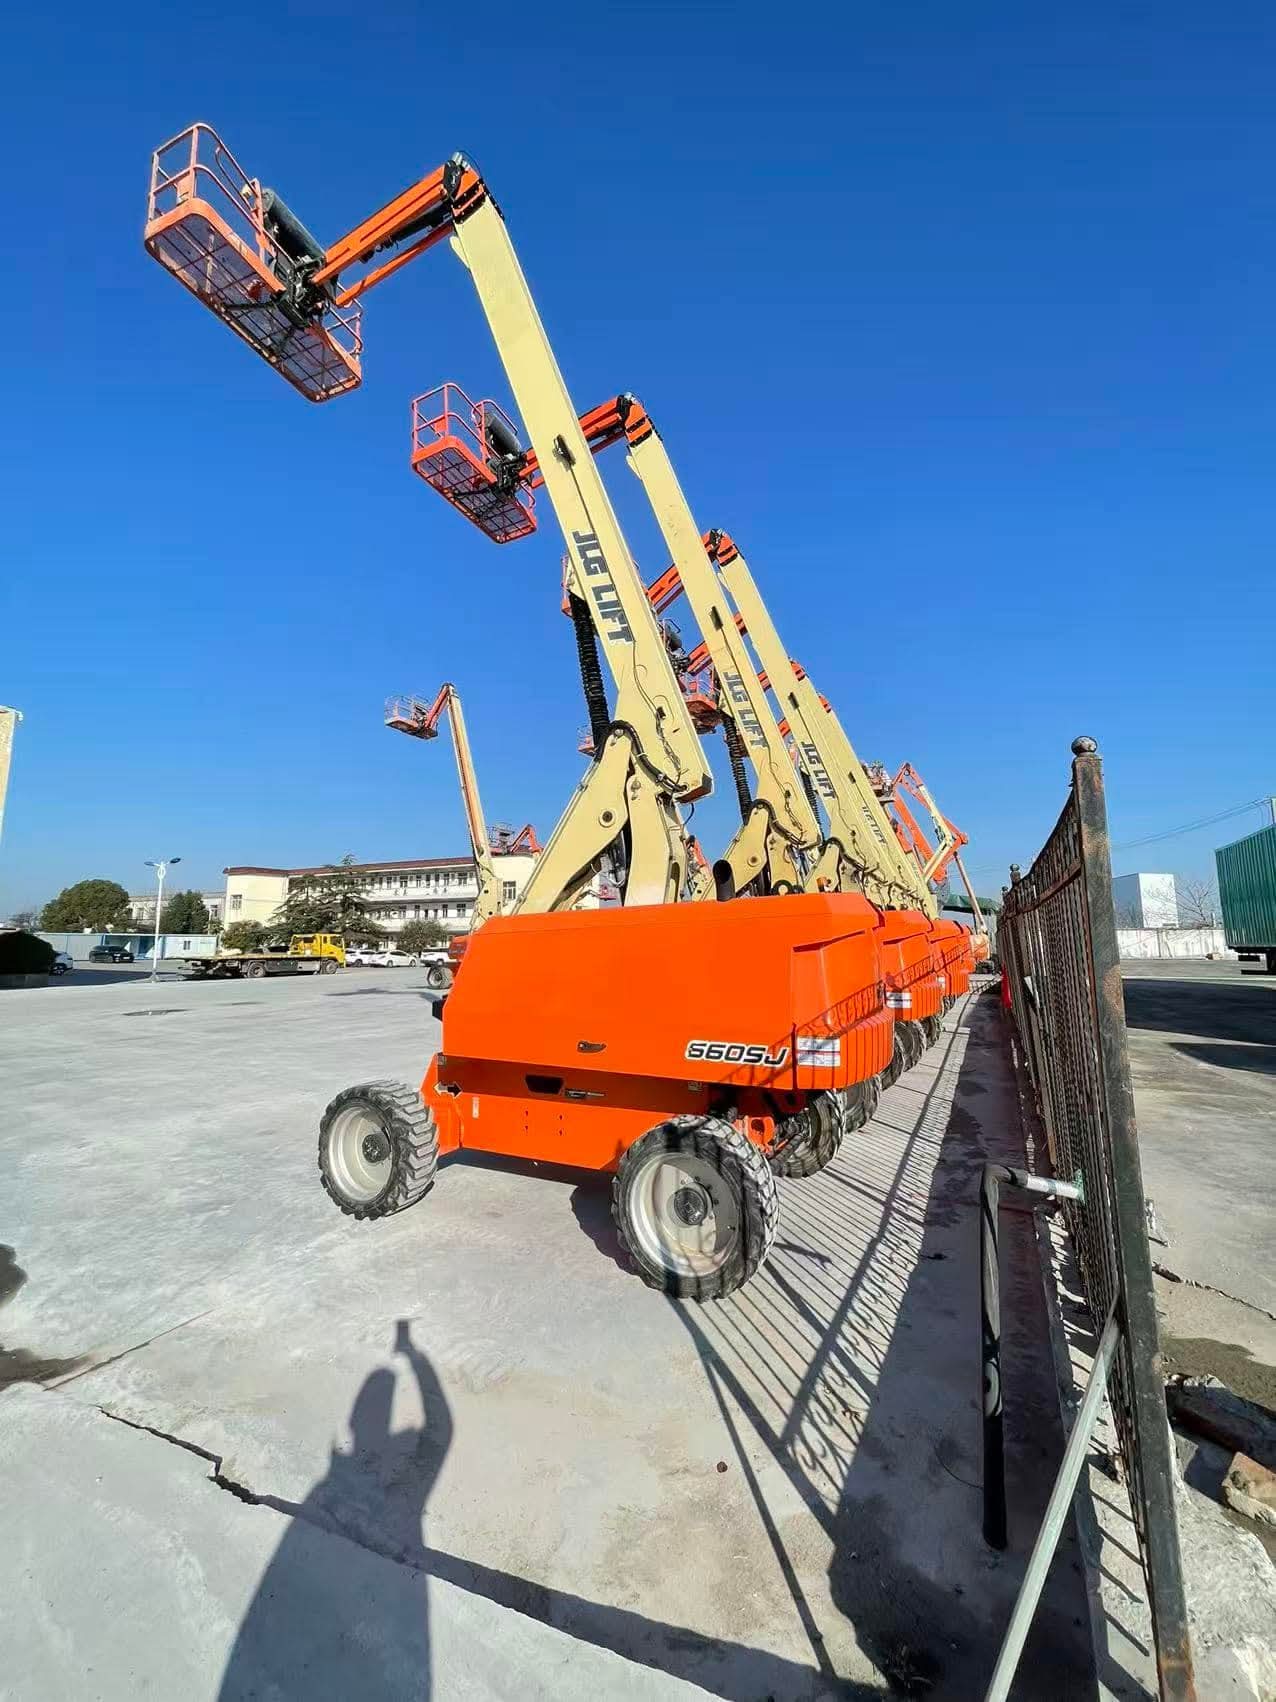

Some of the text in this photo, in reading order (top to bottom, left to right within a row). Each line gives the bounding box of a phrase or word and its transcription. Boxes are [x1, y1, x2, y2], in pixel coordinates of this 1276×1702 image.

[572, 530, 634, 643] JLG LIFT
[723, 671, 768, 748] JLG LIFT
[801, 741, 835, 799] JLG LIFT
